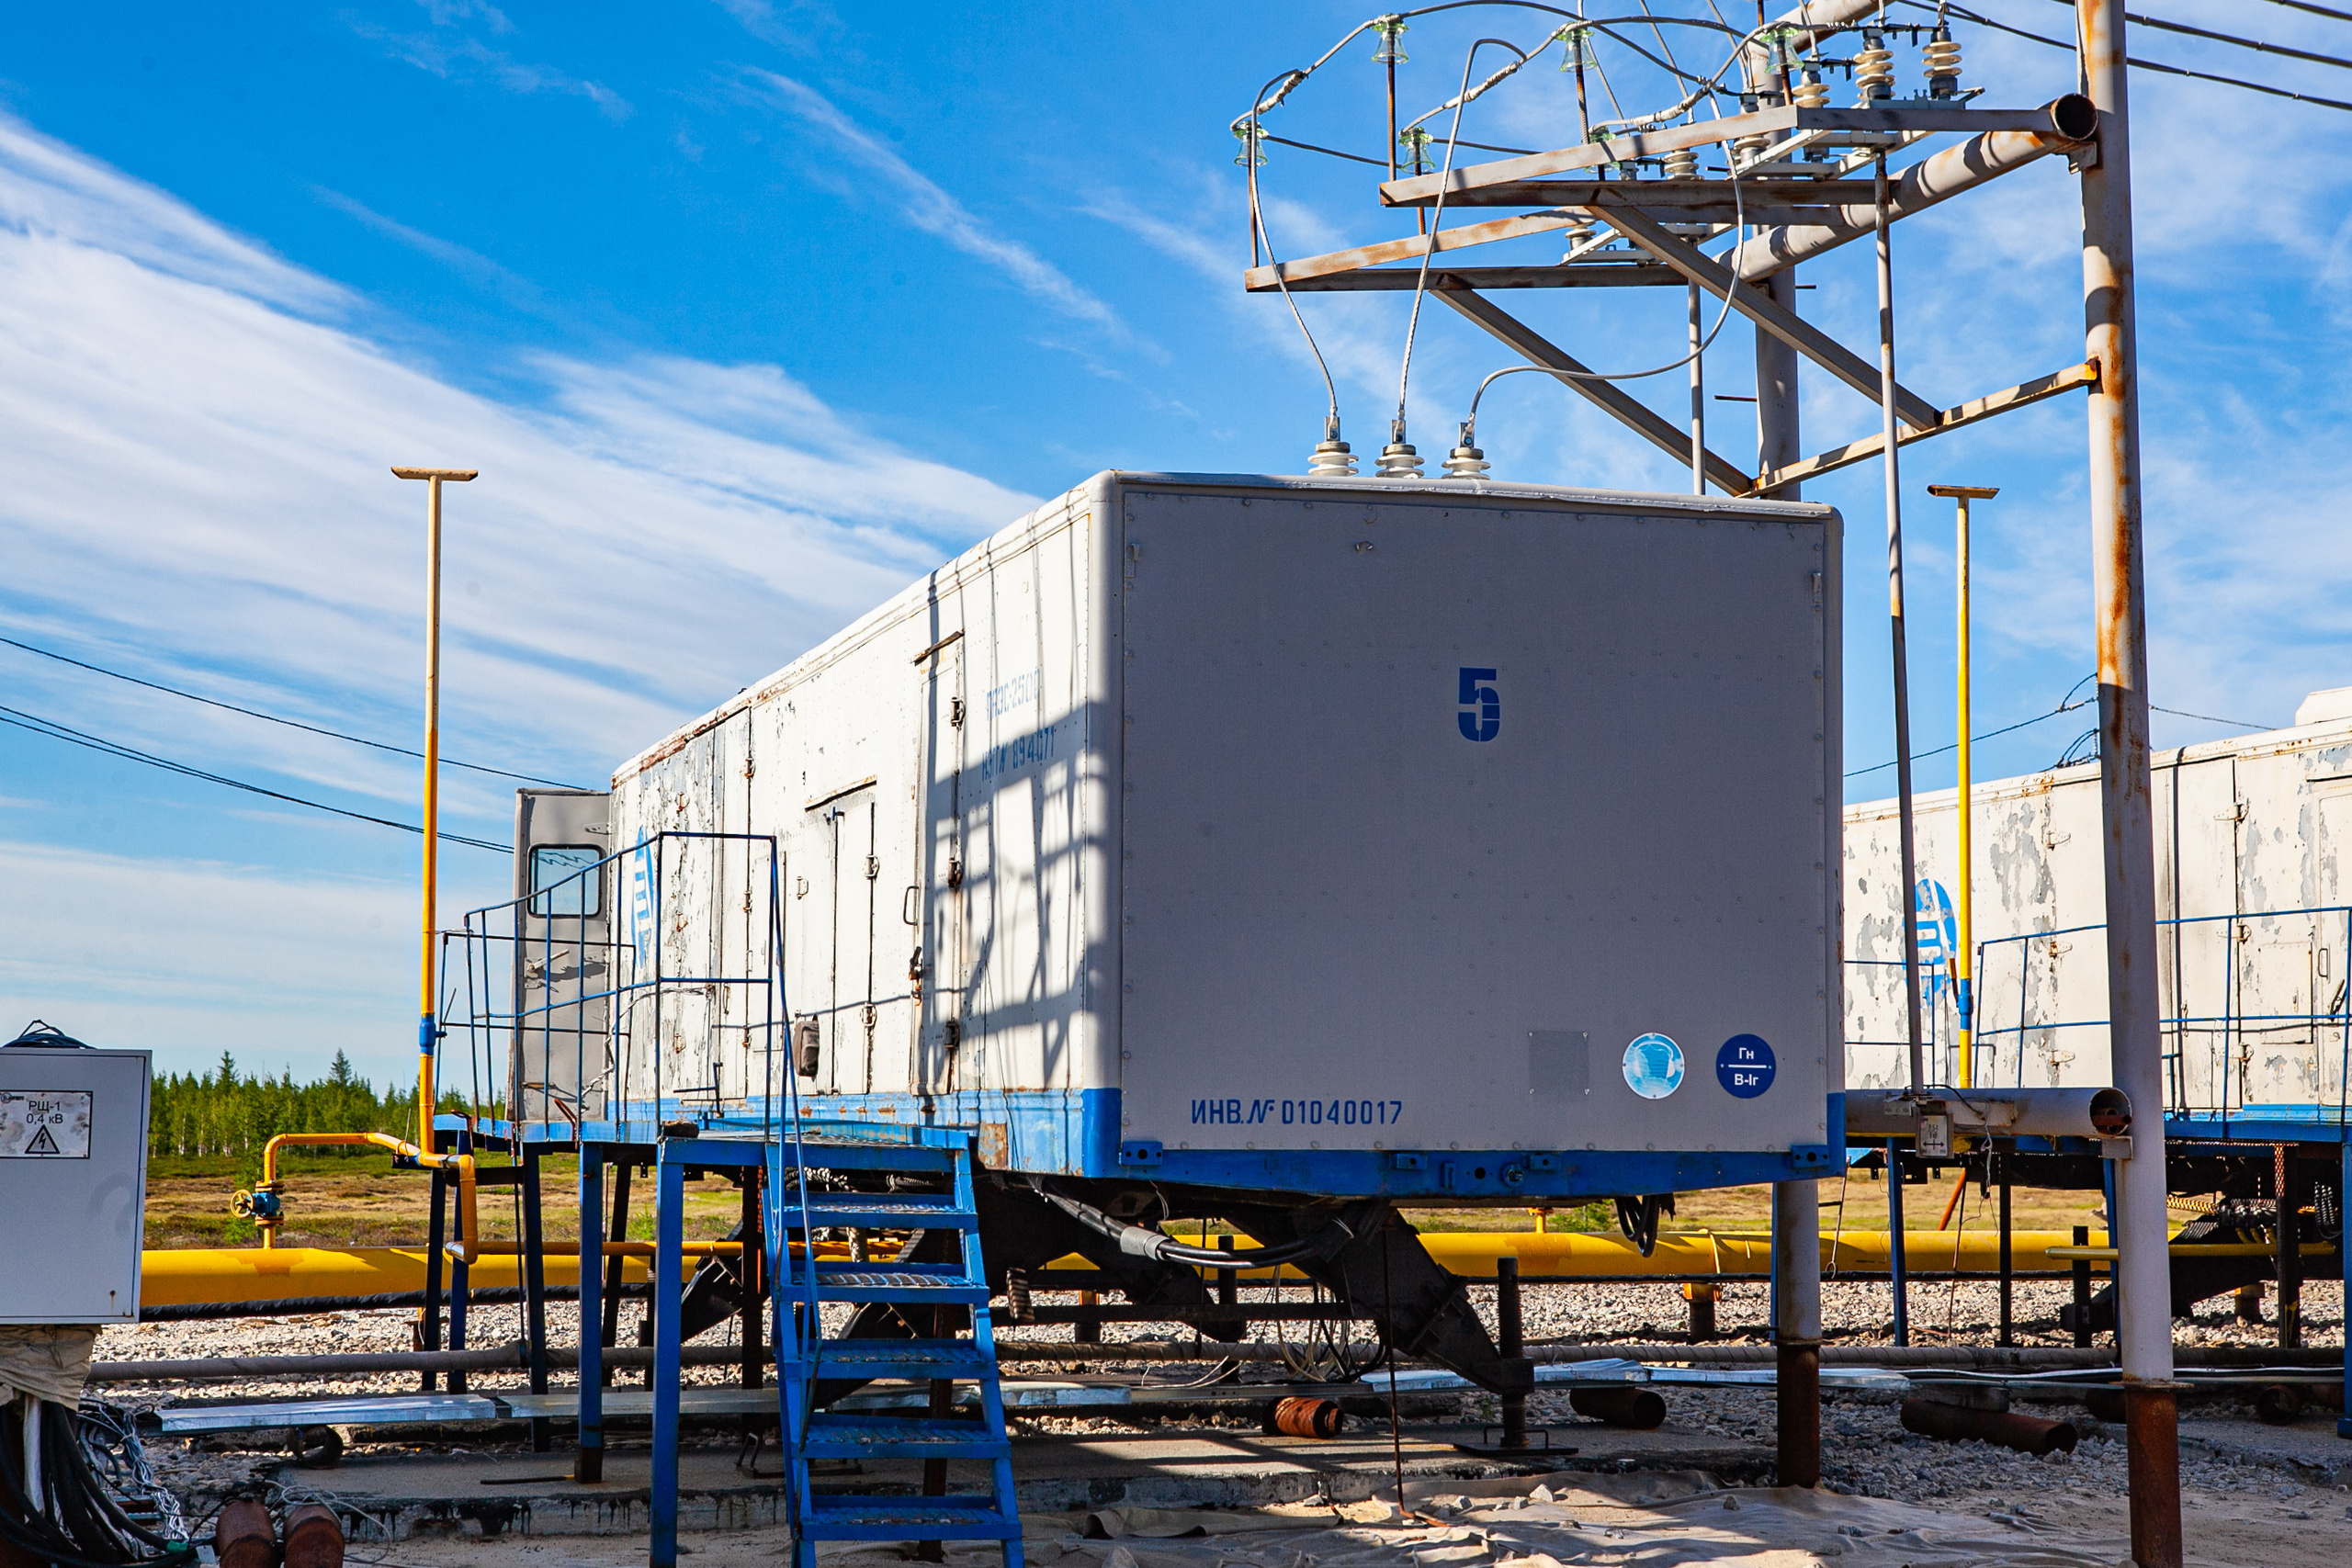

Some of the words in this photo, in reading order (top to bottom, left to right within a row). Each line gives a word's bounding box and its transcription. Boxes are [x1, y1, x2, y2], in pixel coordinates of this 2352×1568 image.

[1457, 667, 1500, 742] 5
[1012, 725, 1055, 770] 894071
[1738, 1046, 1755, 1060] Гн
[28, 1100, 61, 1113] РЩ-1
[1282, 1100, 1403, 1125] 01040017
[26, 1112, 45, 1125] 0,4
[49, 1113, 63, 1124] кВ
